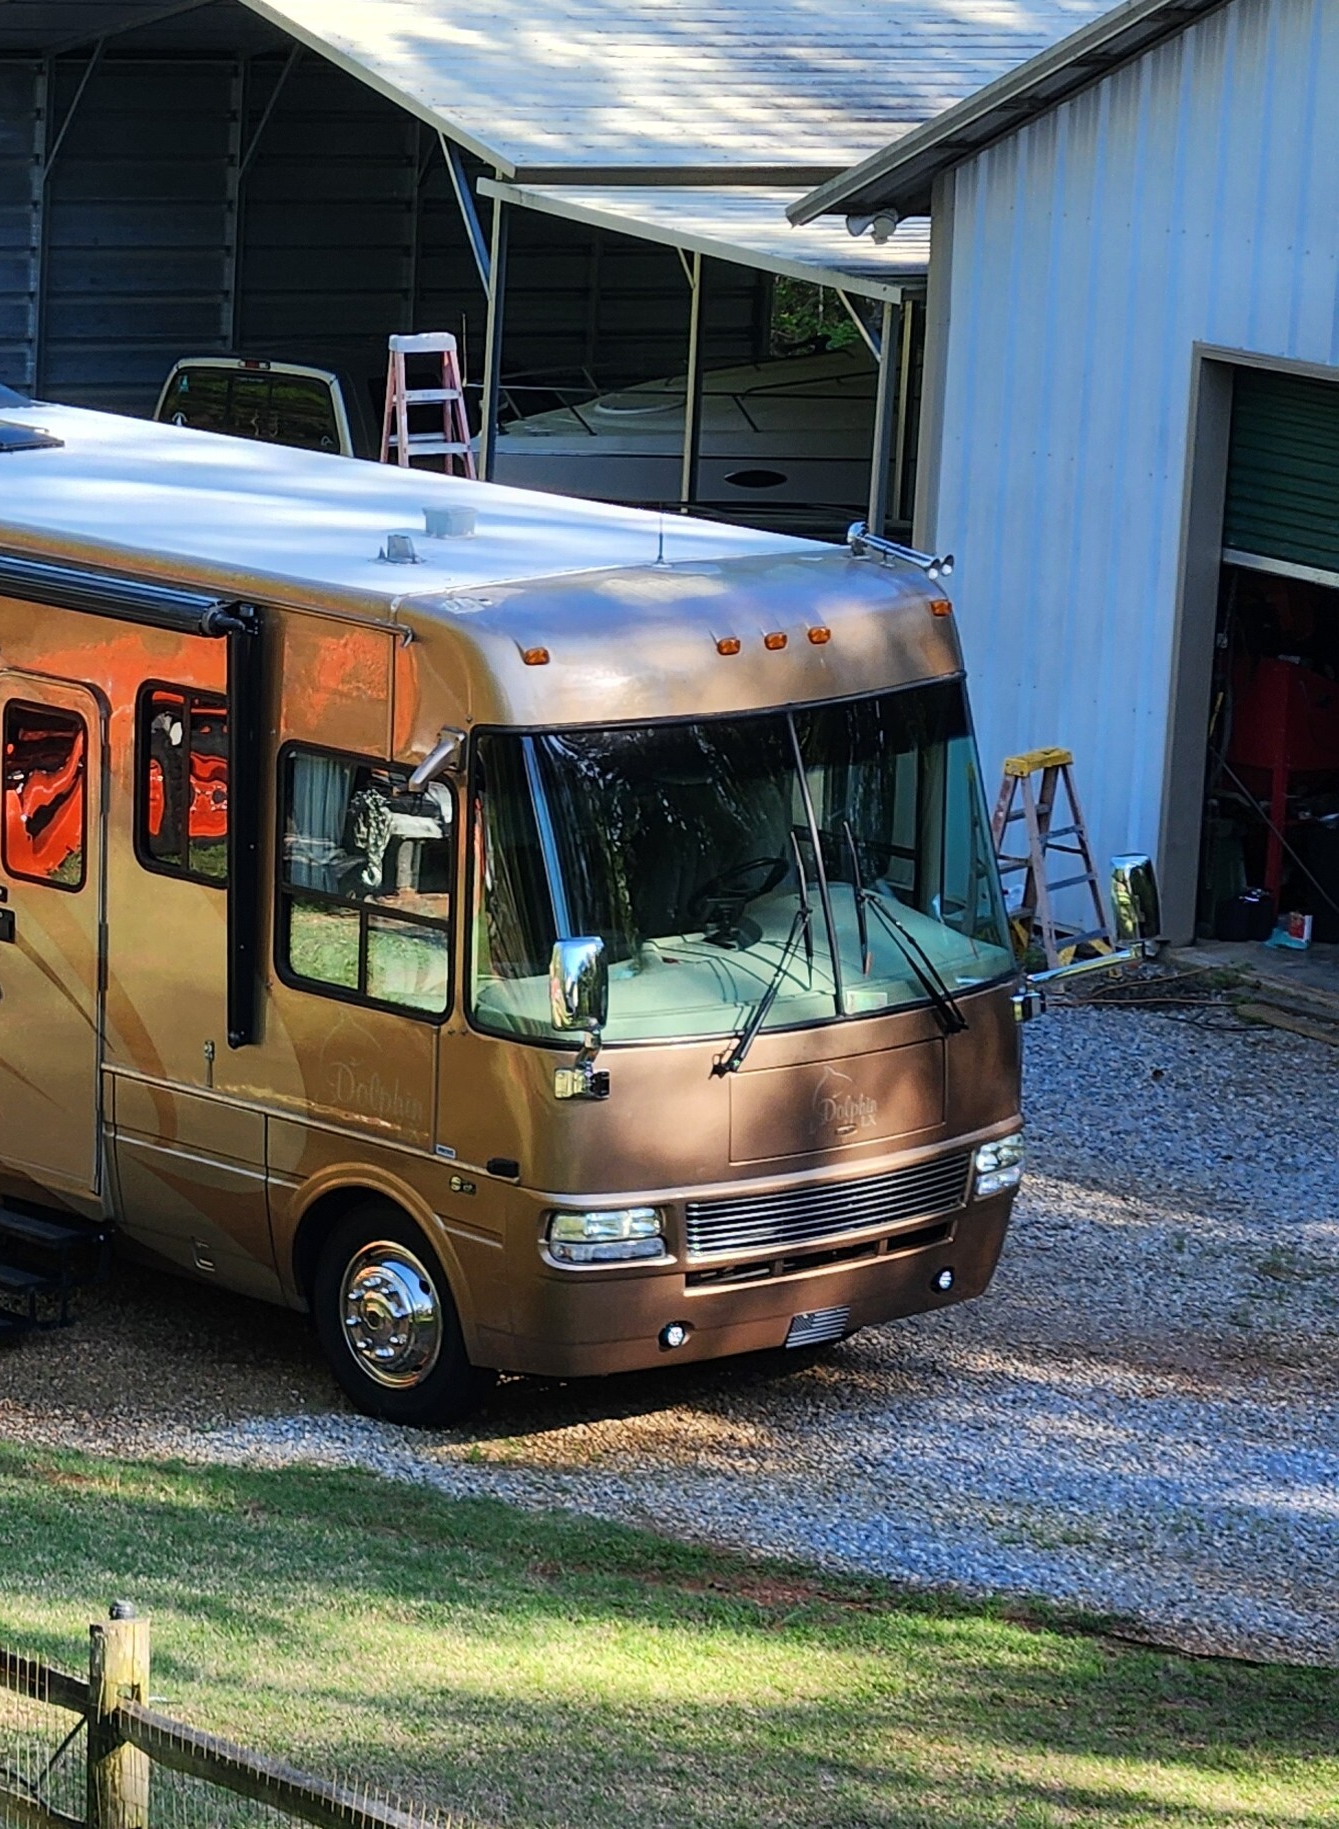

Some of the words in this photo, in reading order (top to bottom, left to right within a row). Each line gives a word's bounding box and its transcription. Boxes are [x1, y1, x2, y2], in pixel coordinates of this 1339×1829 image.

[326, 1062, 423, 1122] Dolphin
[819, 1094, 878, 1123] Dolphin
[861, 1114, 878, 1128] LX
